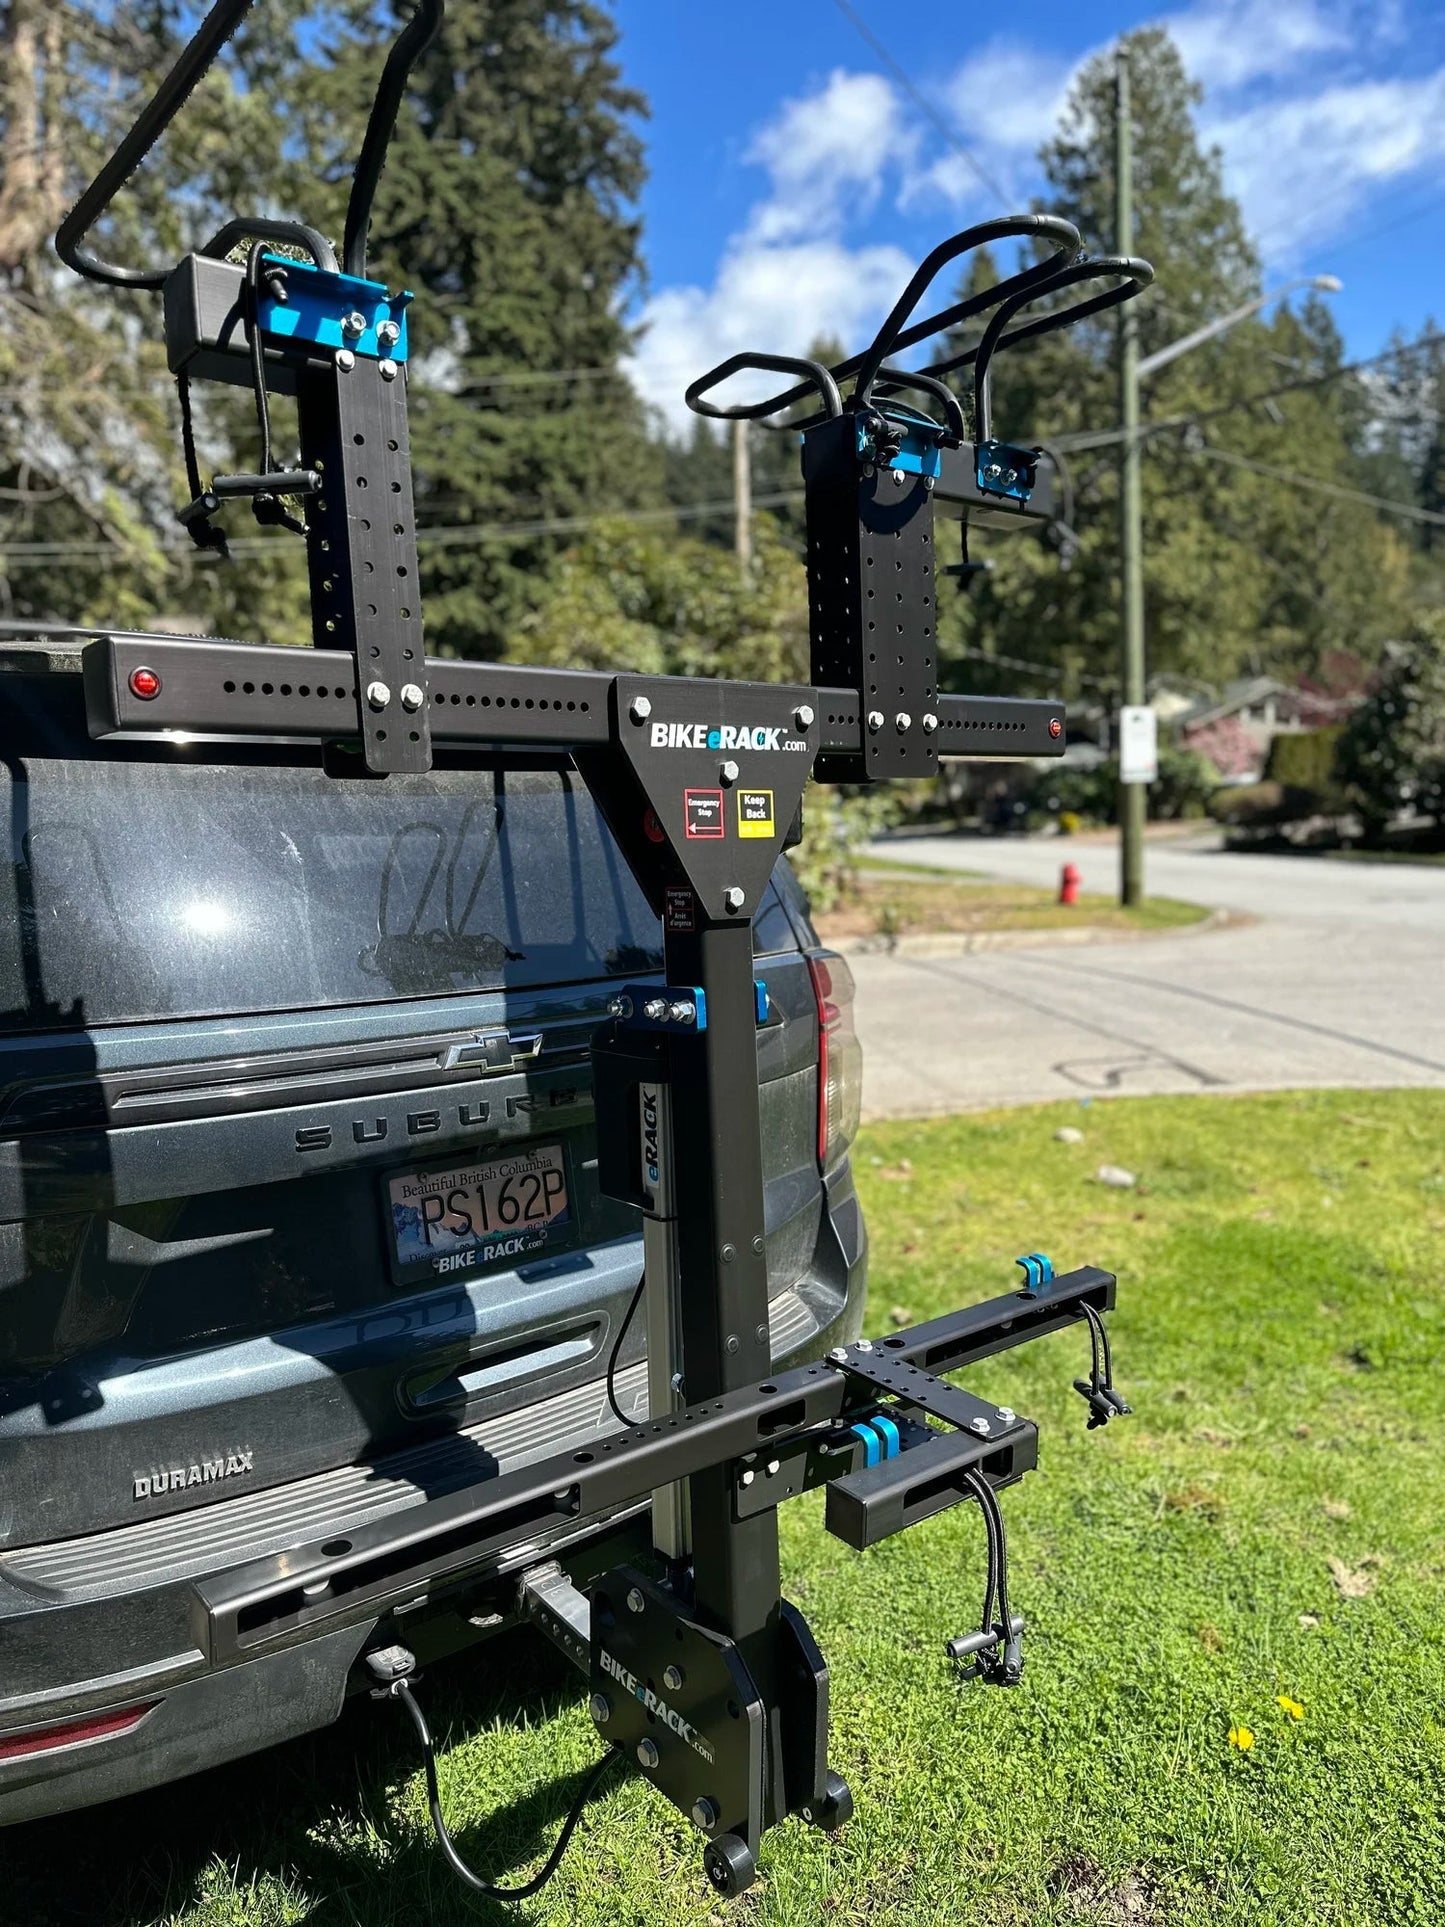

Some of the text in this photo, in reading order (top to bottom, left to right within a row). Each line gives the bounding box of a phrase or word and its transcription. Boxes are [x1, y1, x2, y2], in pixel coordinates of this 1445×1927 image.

[687, 798, 720, 808] Emergency
[697, 808, 713, 818] Stop
[744, 794, 766, 807] Keep
[746, 808, 767, 819] Back
[643, 1089, 659, 1181] eRACK
[401, 1157, 553, 1198] Beautiful British Columbia
[420, 1168, 564, 1245] PS162P
[133, 1451, 253, 1500] DURAMAX
